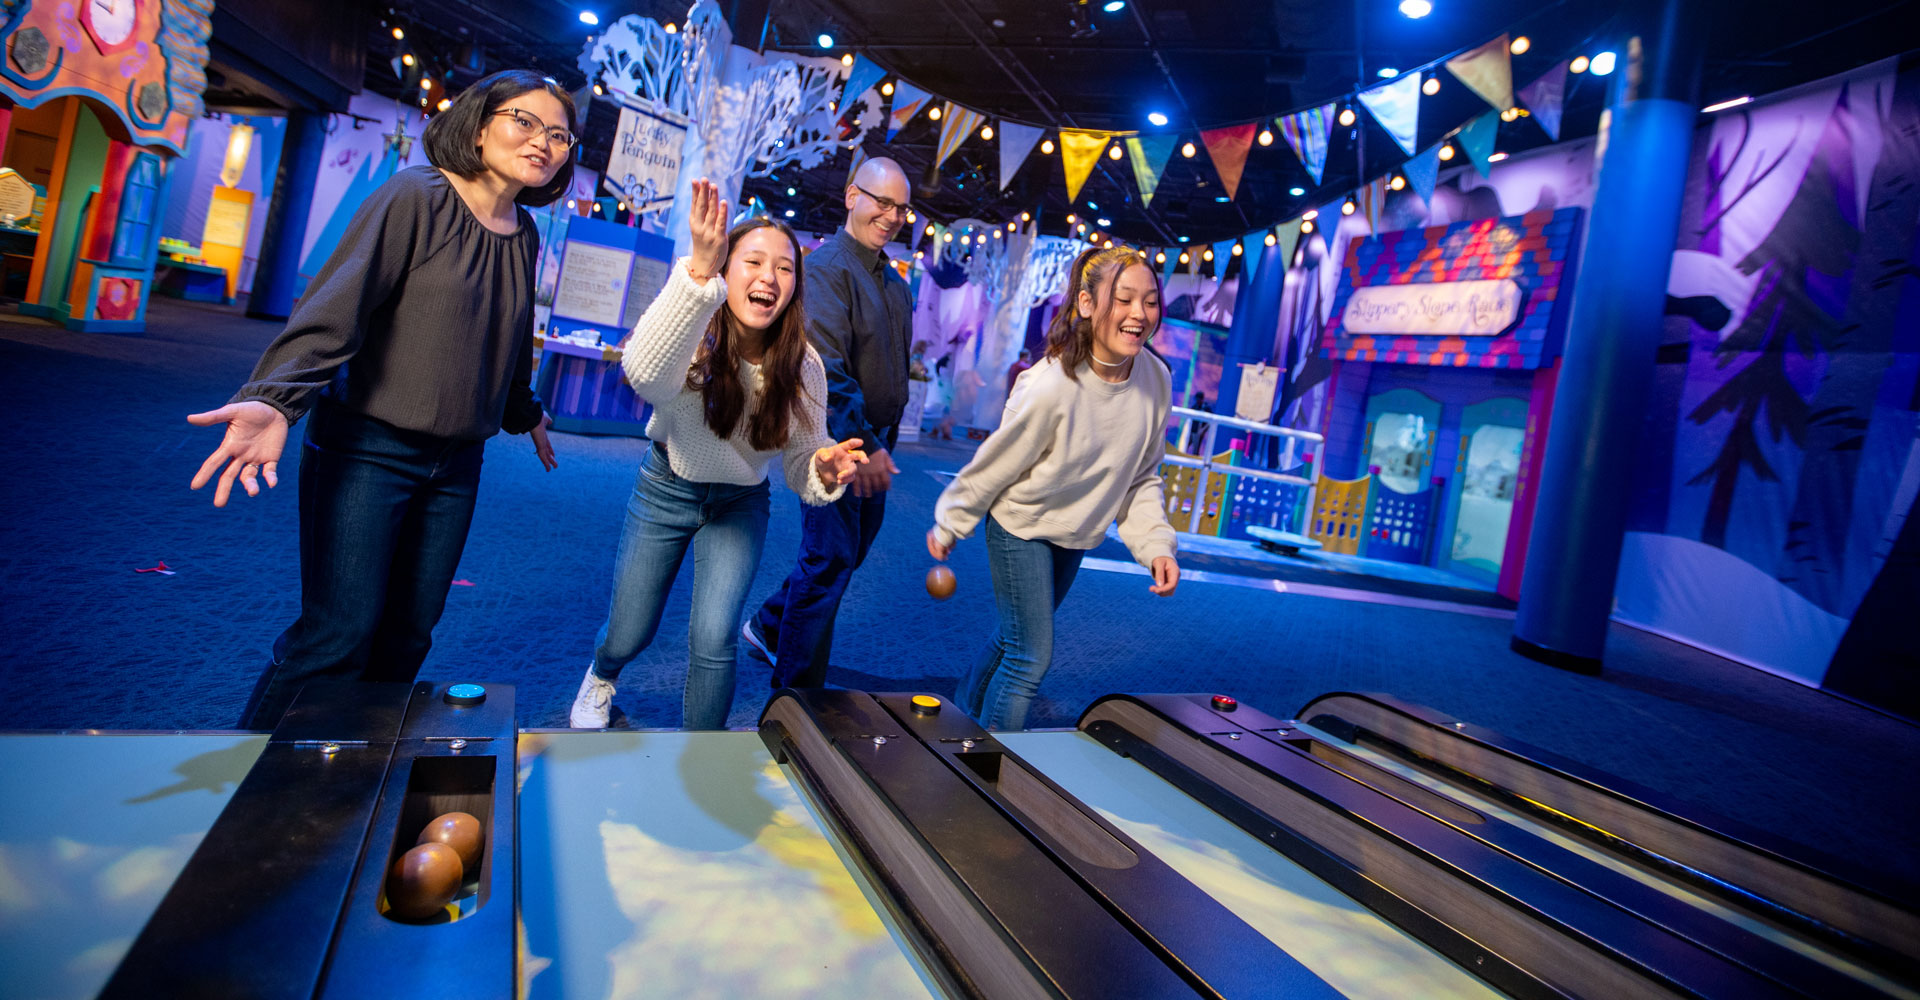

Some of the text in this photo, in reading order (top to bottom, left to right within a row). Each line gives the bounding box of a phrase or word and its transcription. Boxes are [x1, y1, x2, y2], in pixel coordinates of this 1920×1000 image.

[633, 116, 671, 148] Lucky
[621, 131, 676, 169] Penguin
[1351, 297, 1409, 323] Slippery
